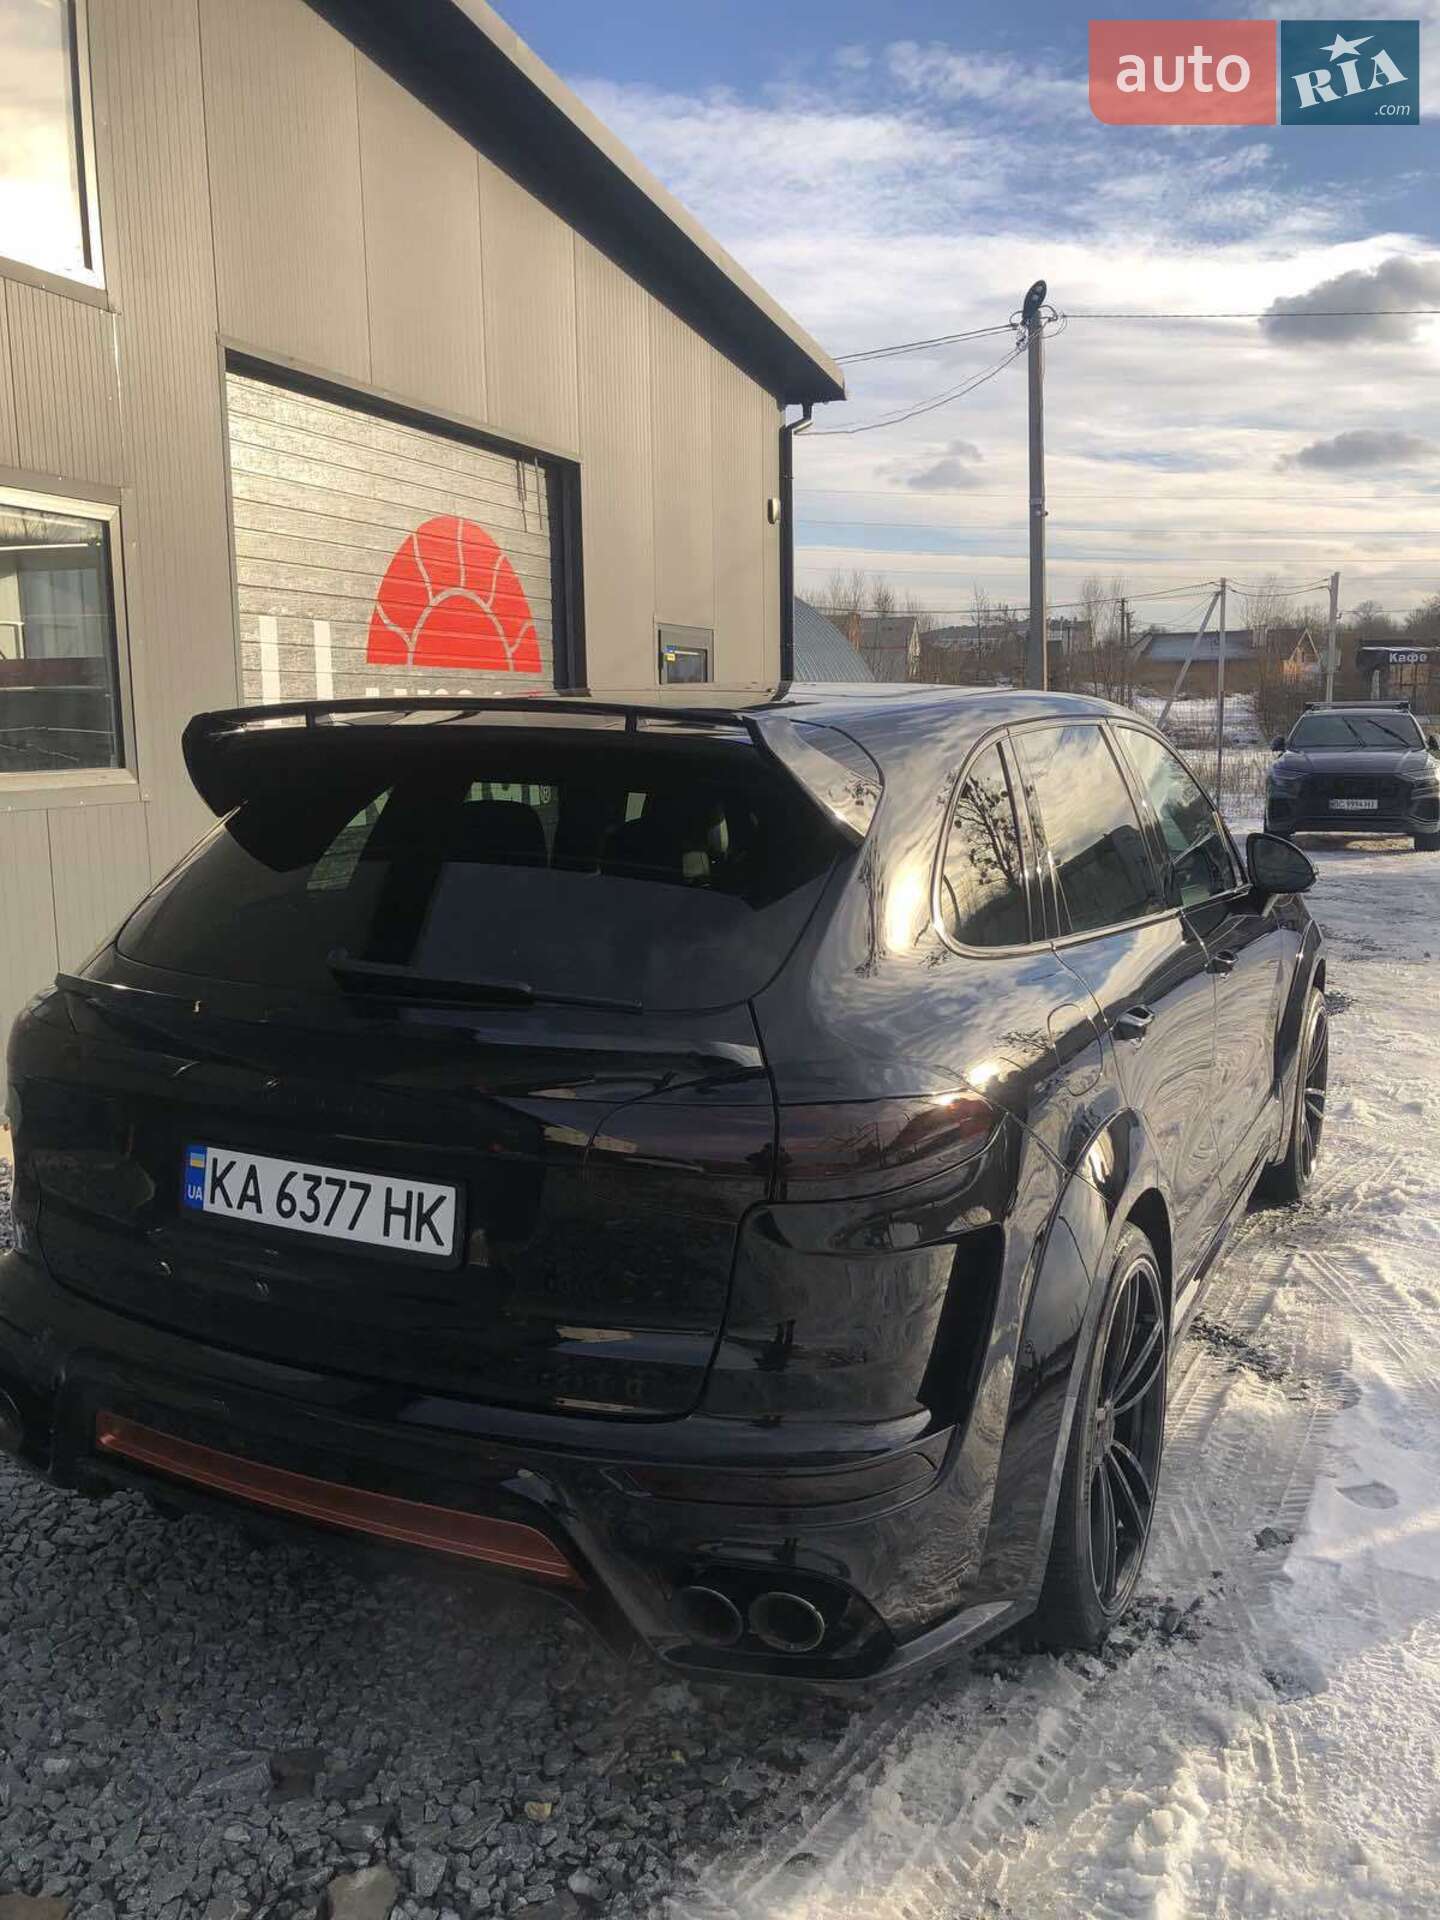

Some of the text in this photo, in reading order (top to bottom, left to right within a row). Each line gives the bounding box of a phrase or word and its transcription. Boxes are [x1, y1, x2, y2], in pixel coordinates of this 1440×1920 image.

[1389, 652, 1428, 664] Кафе
[187, 1184, 203, 1200] UA
[209, 1156, 448, 1247] KA 6377 HK
